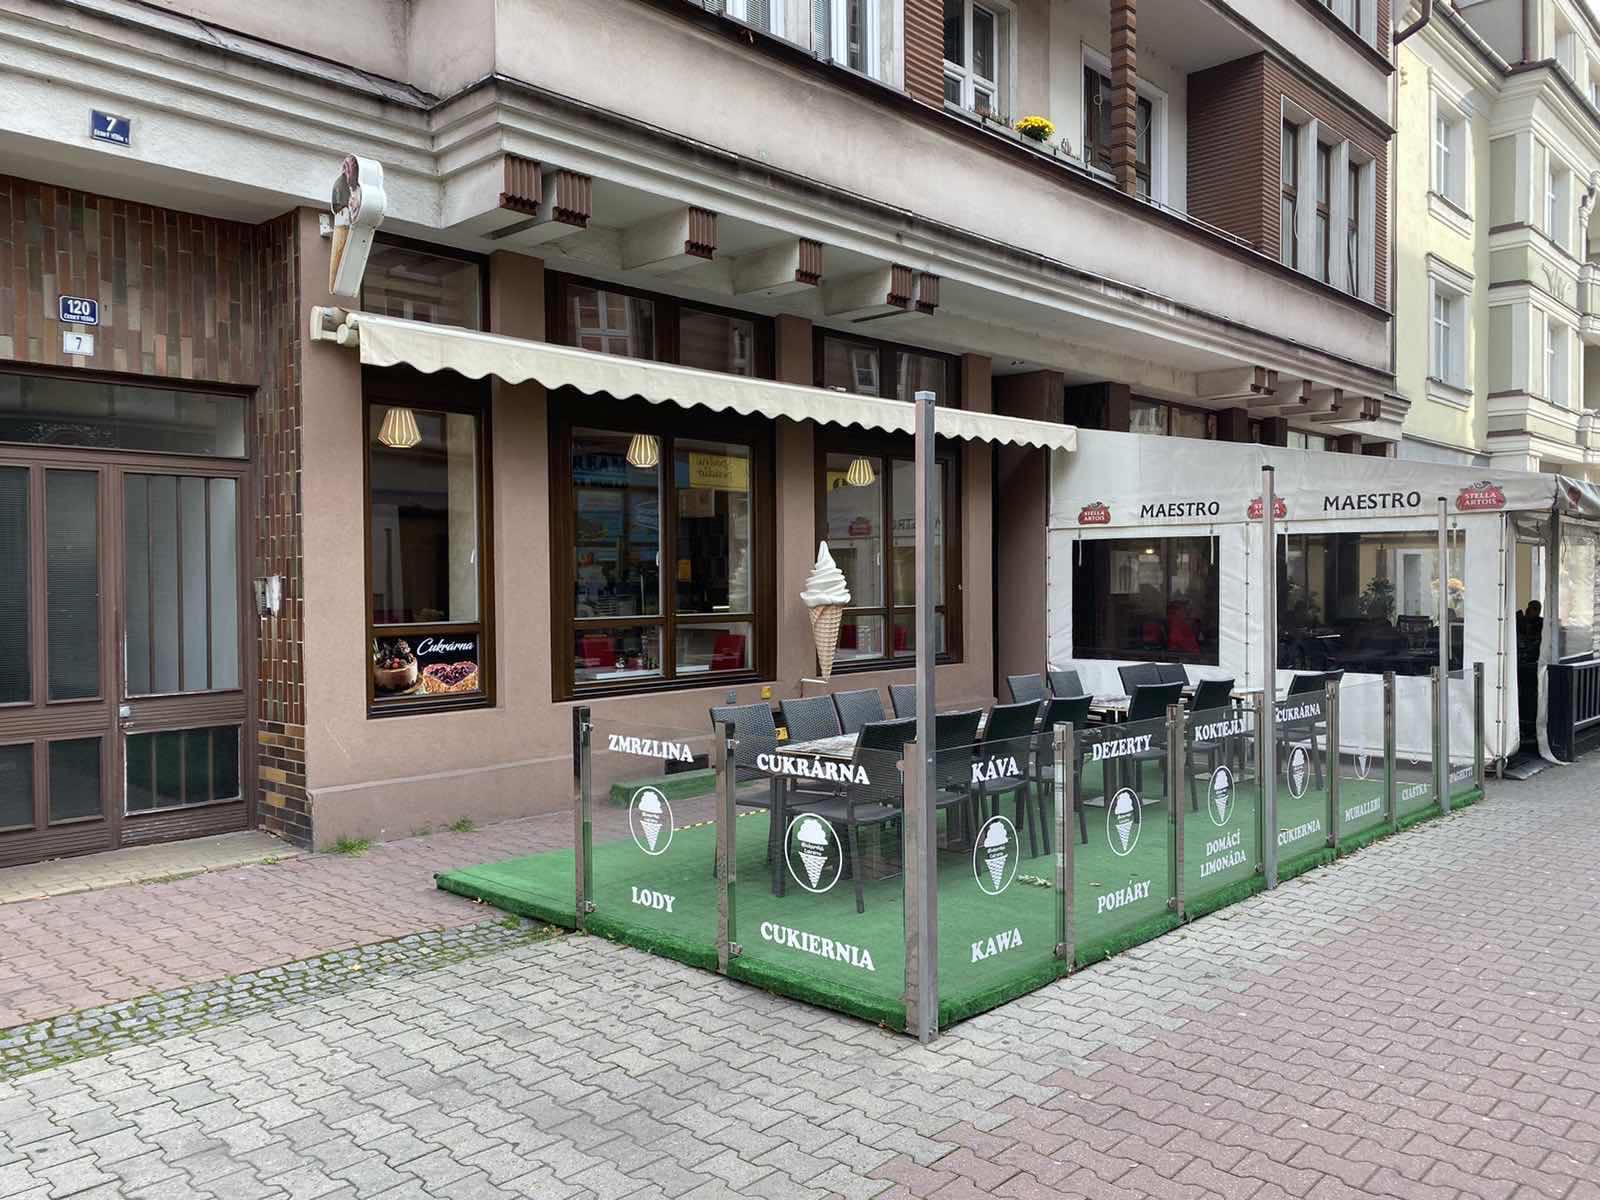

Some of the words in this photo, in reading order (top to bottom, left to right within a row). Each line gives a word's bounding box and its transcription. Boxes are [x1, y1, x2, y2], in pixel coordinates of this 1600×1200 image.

[106, 116, 117, 131] 7
[68, 299, 90, 316] 120
[76, 336, 82, 350] 7
[1323, 490, 1421, 512] MAESTRO
[1464, 491, 1497, 499] STELLA
[1464, 498, 1497, 506] ARTOIS
[1140, 501, 1220, 519] MAESTRO
[416, 637, 474, 656] Cukrárna
[1276, 702, 1321, 722] CUKRÁRNA
[1195, 718, 1247, 742] KOKTEJLY
[608, 734, 694, 762] ZMRZLINA
[1092, 734, 1153, 762] DEZERTY
[756, 753, 870, 785] CUKRÁRNA
[971, 755, 1020, 784] KÁVA
[1206, 828, 1241, 857] DOMÁCÍ
[1277, 818, 1321, 846] CUKIERNIA
[1200, 849, 1247, 878] LIMONÁDA
[631, 886, 676, 913] LODY
[1097, 880, 1151, 914] POHÁRY
[760, 921, 876, 972] CUKIERNIA
[971, 927, 1023, 964] KAWA
